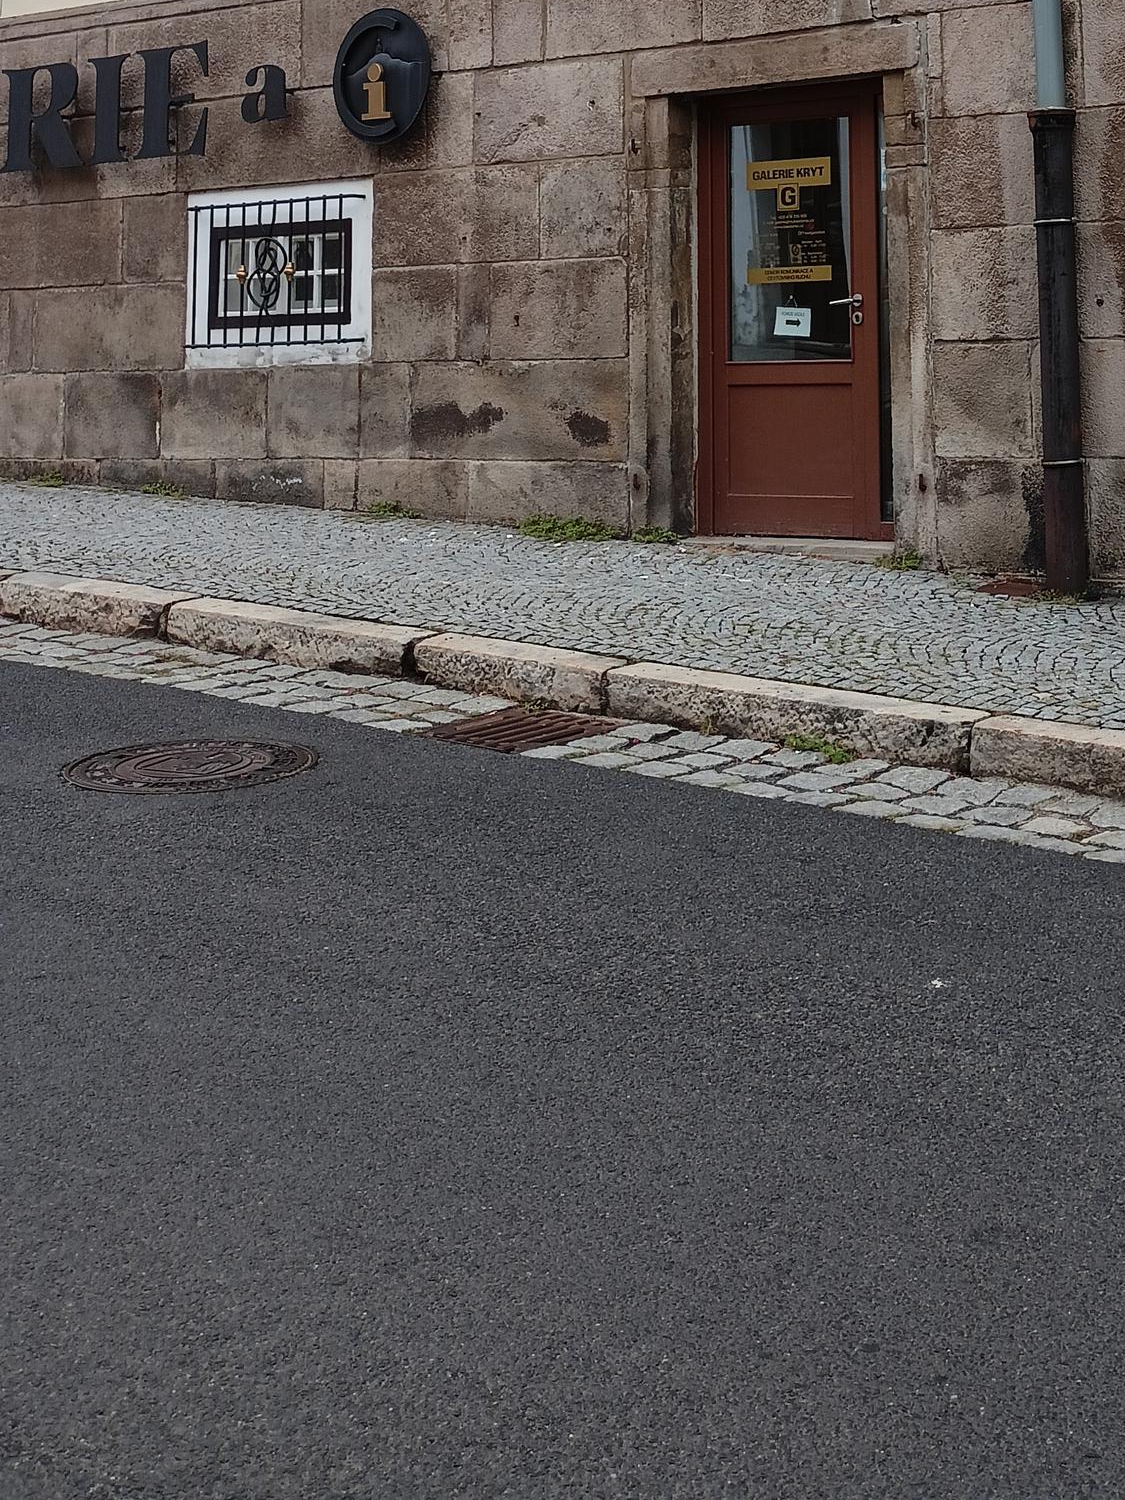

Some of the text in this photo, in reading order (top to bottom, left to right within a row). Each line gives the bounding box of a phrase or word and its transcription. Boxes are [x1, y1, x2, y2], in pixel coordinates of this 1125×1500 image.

[1, 40, 209, 173] RIE
[241, 64, 291, 124] a
[752, 166, 825, 181] GALERIE KRYT
[780, 186, 796, 206] G
